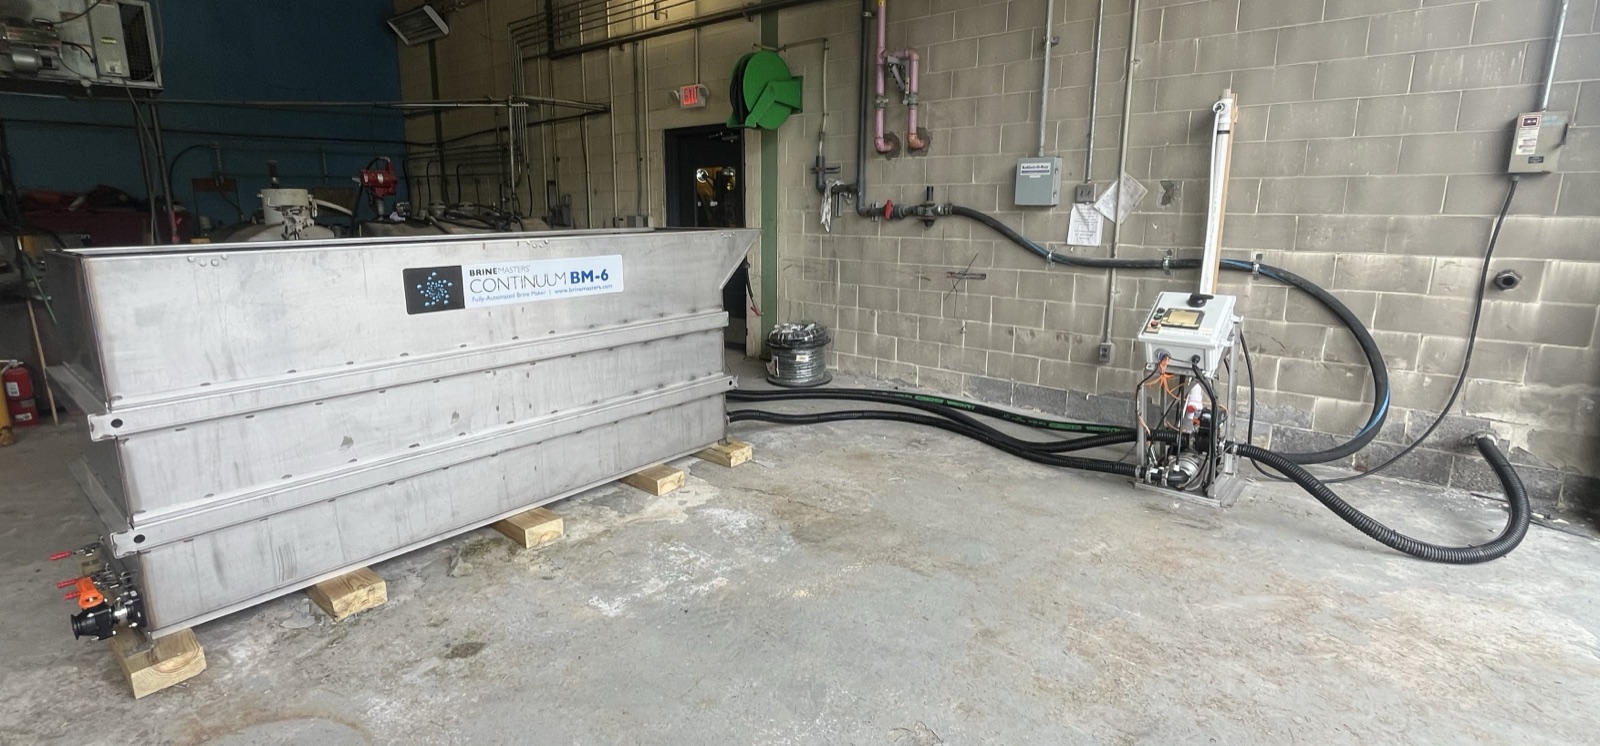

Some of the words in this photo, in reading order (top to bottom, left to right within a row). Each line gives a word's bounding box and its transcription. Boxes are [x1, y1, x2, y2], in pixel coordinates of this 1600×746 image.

[469, 271, 567, 294] CONTINUUM
[570, 268, 609, 284] BM-6
[554, 284, 613, 294] www.brinemasters.com
